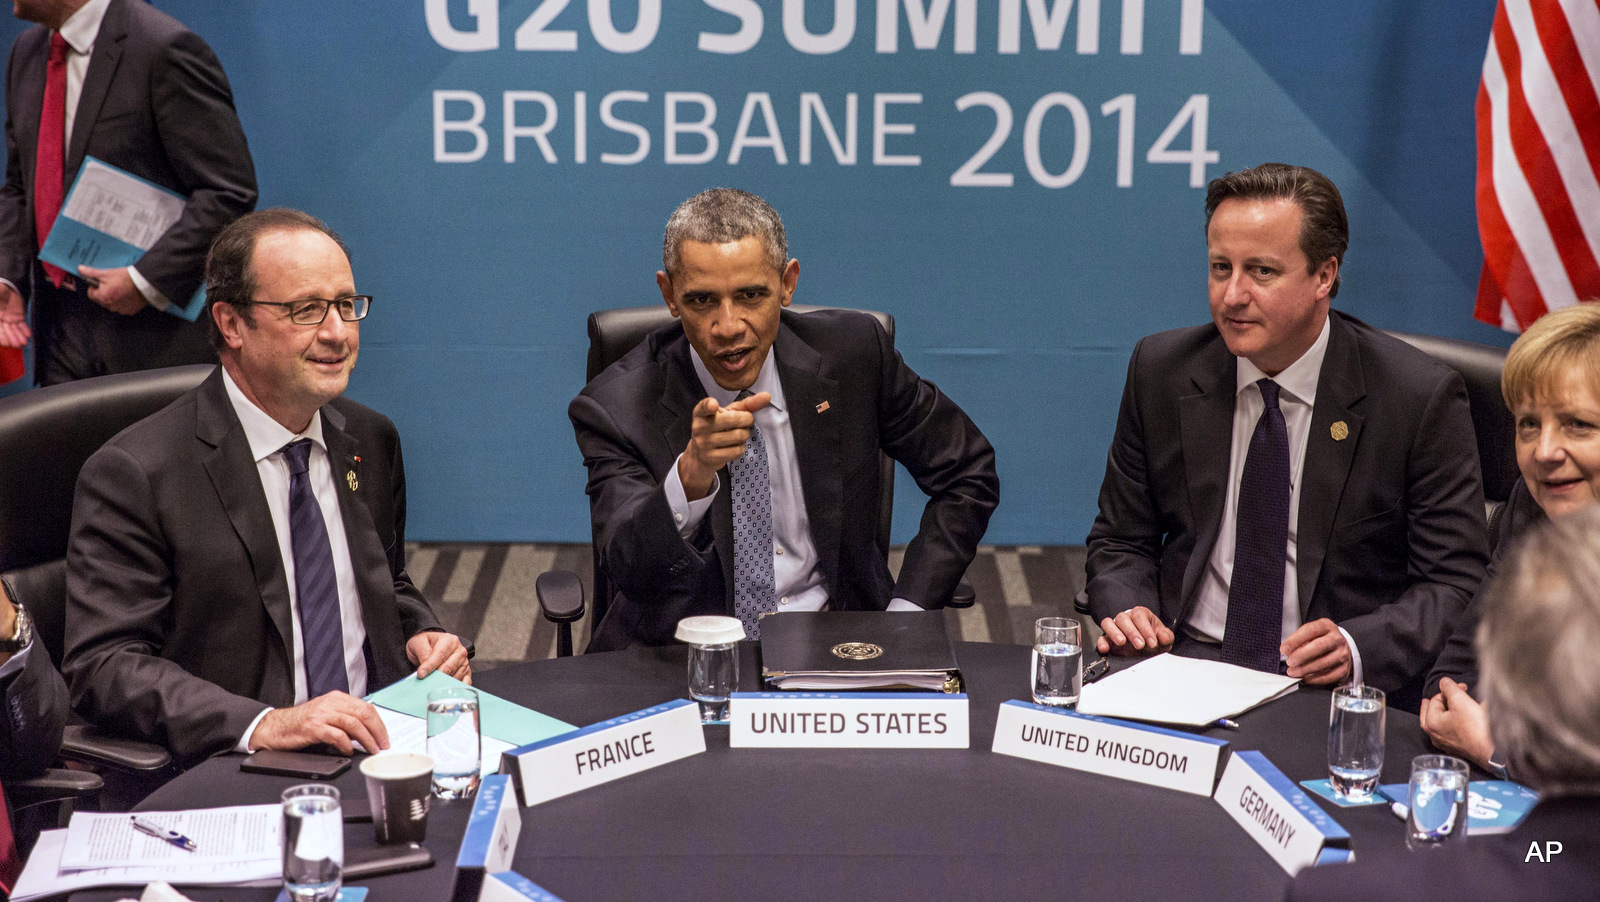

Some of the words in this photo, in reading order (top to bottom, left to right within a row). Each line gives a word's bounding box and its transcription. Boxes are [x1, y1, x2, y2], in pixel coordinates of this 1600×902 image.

[424, 0, 662, 54] G20
[432, 89, 923, 166] BRISBANE
[950, 91, 1221, 189] 2014
[750, 712, 847, 735] UNITED
[855, 712, 948, 735] STATES
[1020, 724, 1091, 754] UNITED
[1094, 738, 1189, 775] KINGDOM
[575, 731, 655, 775] FRANCE
[1239, 784, 1297, 849] GERMANY
